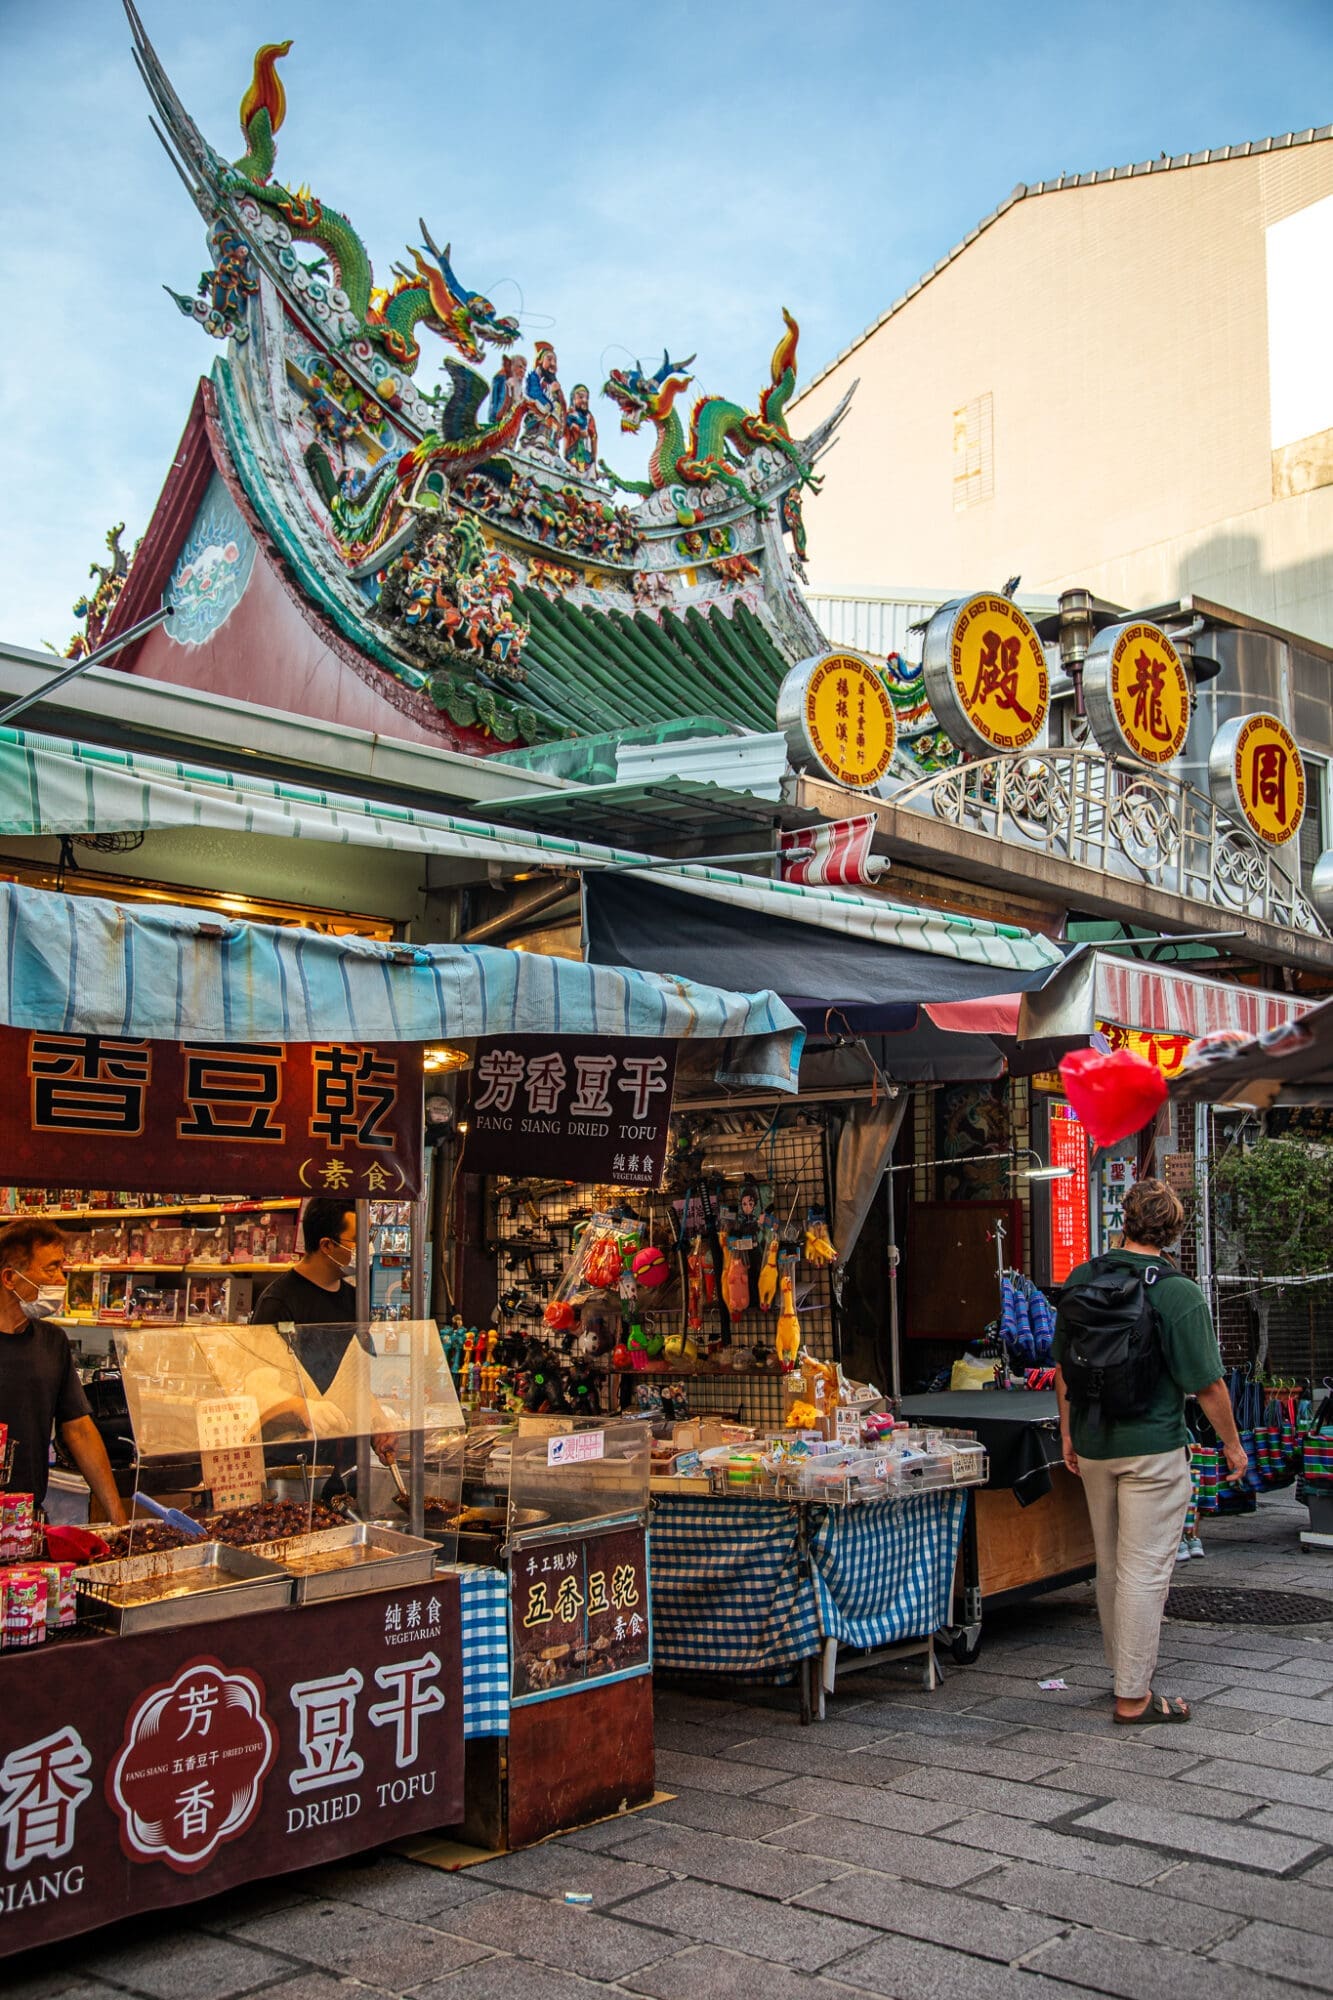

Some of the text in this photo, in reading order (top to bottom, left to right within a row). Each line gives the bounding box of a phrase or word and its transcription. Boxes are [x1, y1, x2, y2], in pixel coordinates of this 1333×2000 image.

[971, 630, 1032, 723] 殿
[1127, 650, 1172, 741] 龍
[1252, 744, 1288, 825] 周
[28, 1031, 398, 1150] 香豆乾
[475, 1050, 667, 1119] 芳香豆干
[477, 1115, 657, 1140] FANG SIANG DRIED TOFU
[612, 1153, 654, 1172] 純素食
[612, 1172, 653, 1182] VEGETARIAN
[526, 1551, 578, 1576] 手工現炒
[385, 1597, 441, 1632] 純素食
[523, 1564, 639, 1628] 五香豆乾
[384, 1625, 441, 1646] VEGETARIAN
[614, 1612, 644, 1640] 素食
[177, 1684, 219, 1741] 芳
[0, 1650, 445, 1871] 香 豆干
[126, 1742, 263, 1782] FANG SIANG 五香豆干 DRIED TOFU
[174, 1780, 215, 1839] 香
[286, 1793, 361, 1833] DRIED
[376, 1770, 437, 1808] TOFU
